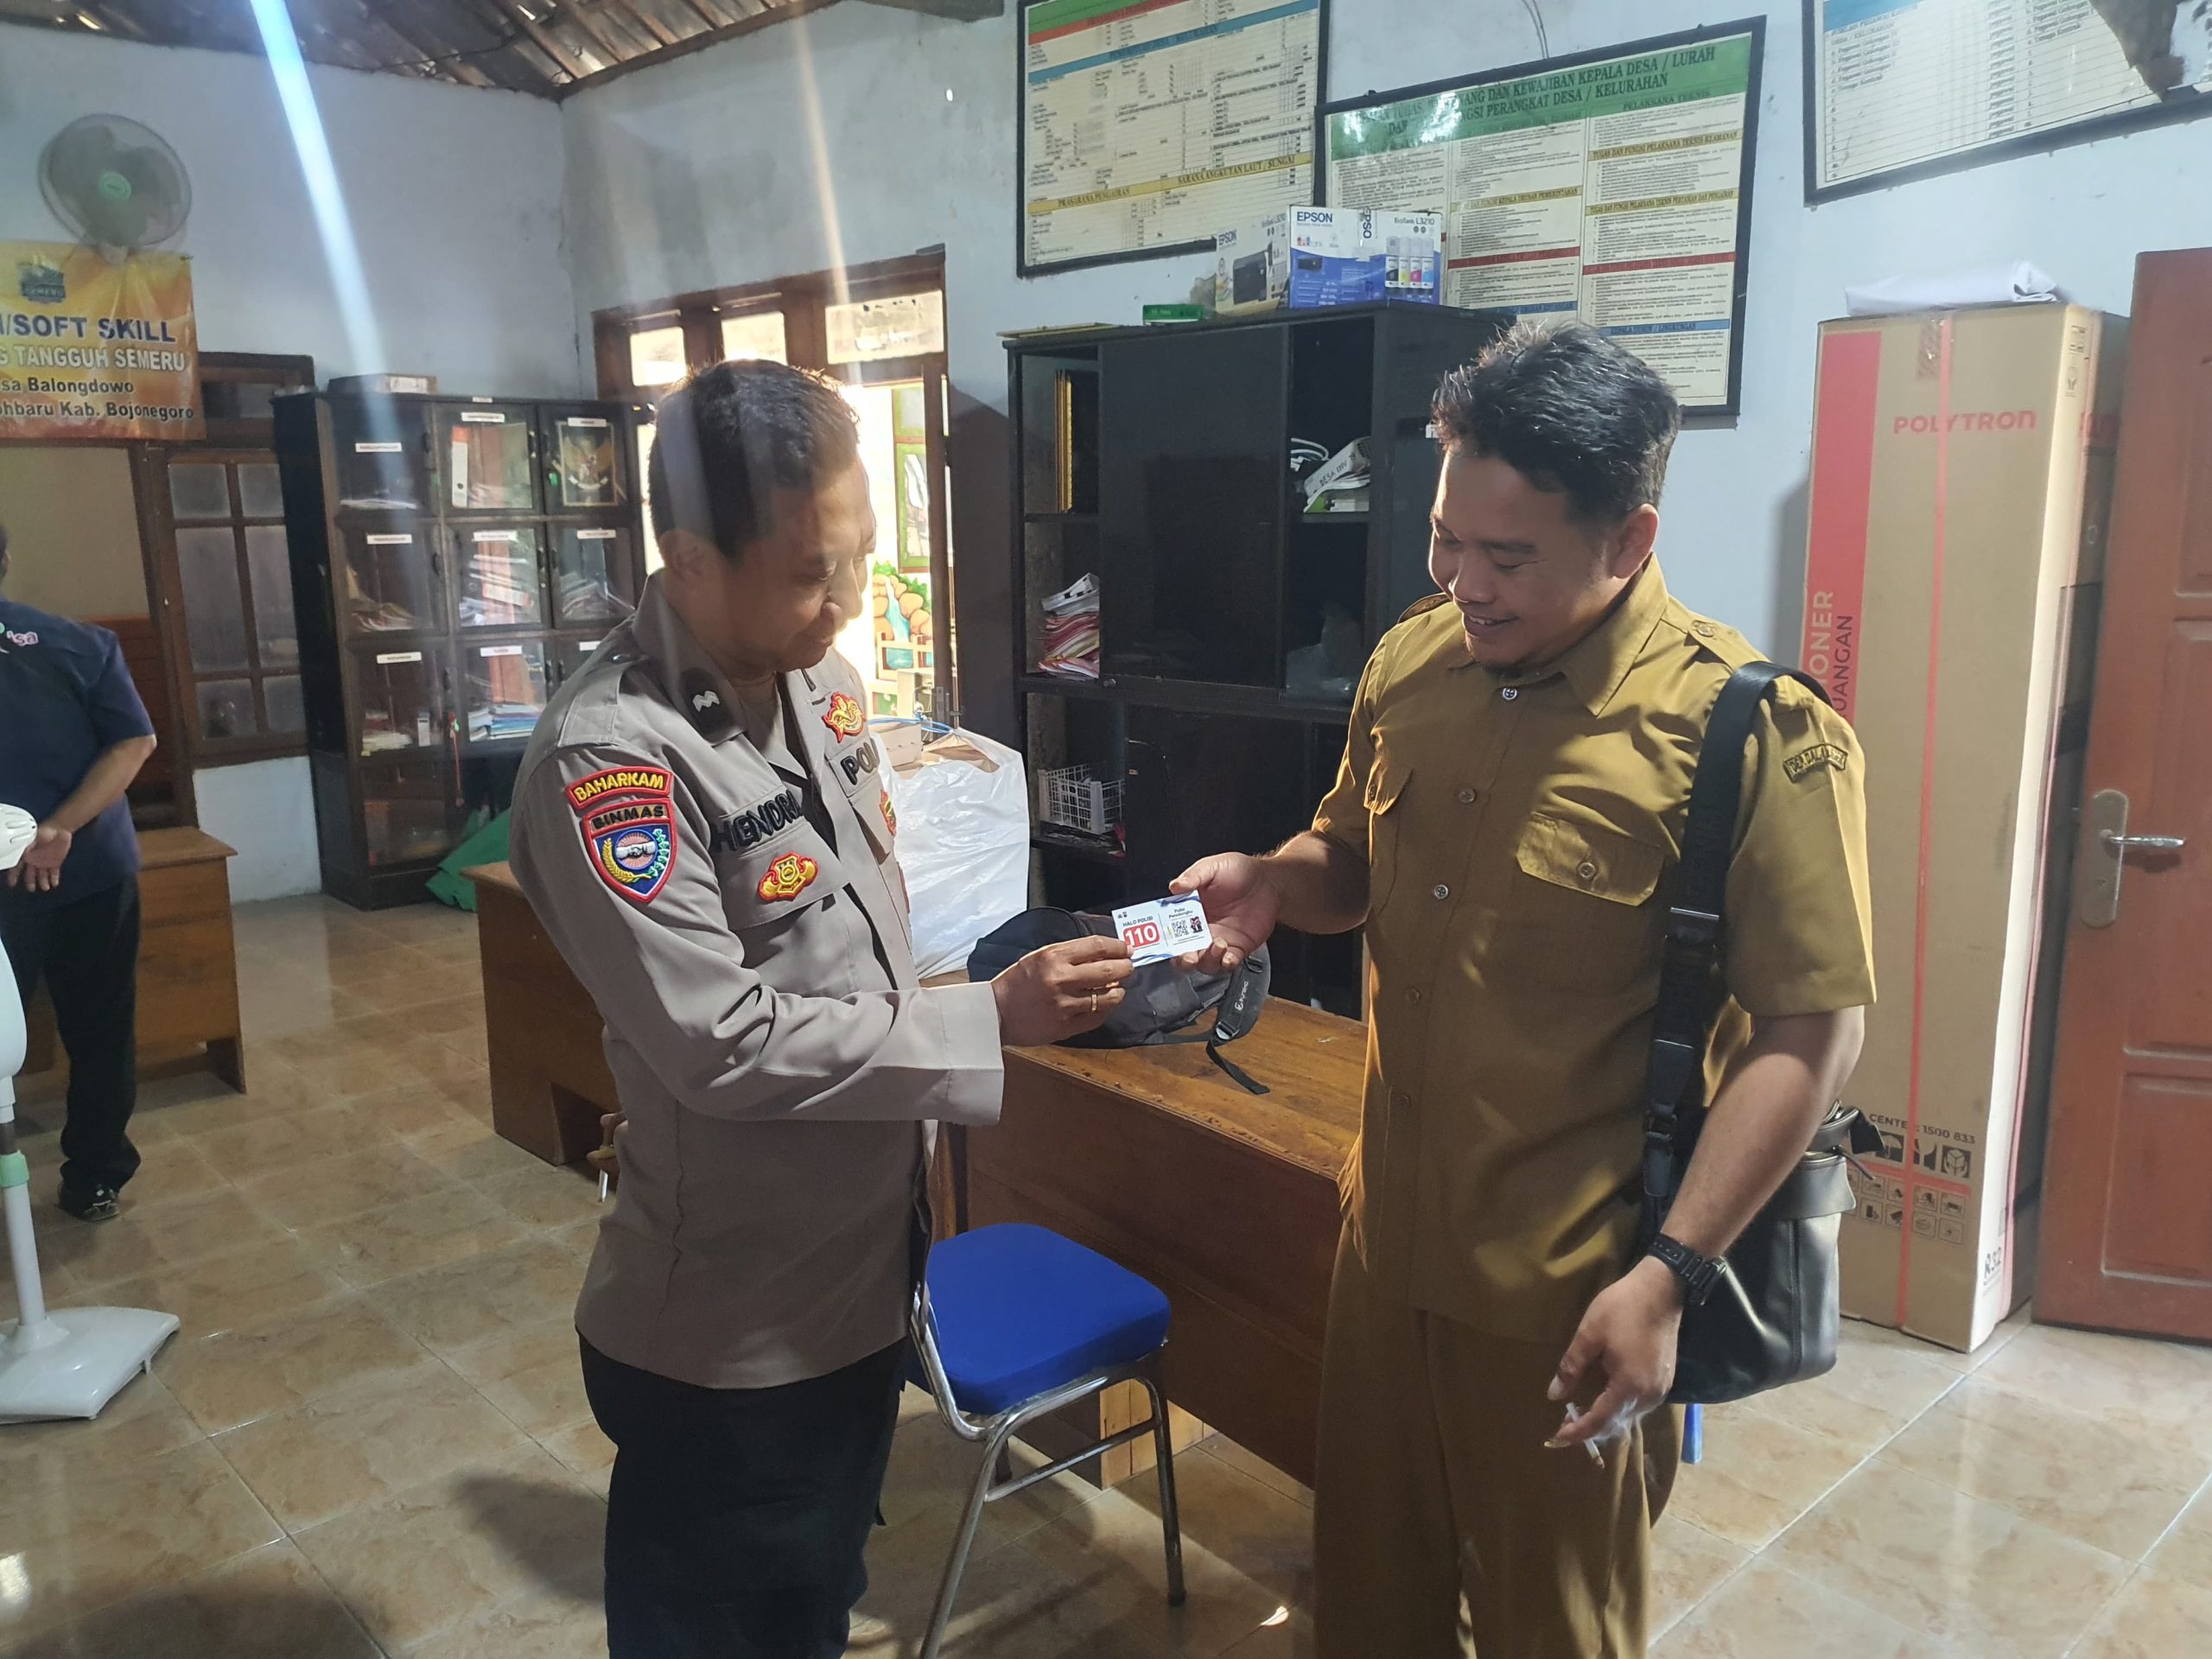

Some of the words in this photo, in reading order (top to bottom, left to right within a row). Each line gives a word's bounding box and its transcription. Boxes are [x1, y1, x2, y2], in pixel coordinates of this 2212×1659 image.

[1488, 84, 1510, 99] DAN
[1514, 72, 1575, 96] KEWAJIBAN
[1579, 65, 1624, 87] KEPALA
[1626, 59, 1658, 76] DESA
[1672, 47, 1716, 67] LURAH
[1486, 95, 1550, 118] PERANGKAT
[1553, 86, 1582, 105] DESA
[1596, 73, 1668, 98] KELURAHAN
[1297, 212, 1332, 223] EPSON
[98, 317, 175, 343] SKILL
[16, 346, 109, 369] TANGGUH
[115, 348, 185, 372] SEMERU
[27, 378, 134, 396] Balongdowo
[61, 402, 100, 417] Kab.
[106, 402, 194, 422] Bojonegoro
[1893, 410, 2037, 435] POLYTRON
[1832, 615, 1853, 712] UANGAN
[573, 772, 664, 802] BAHARKAM
[592, 805, 664, 830] BINMAS
[1137, 916, 1154, 925] POLISI
[1124, 925, 1158, 948] 110
[1869, 1114, 1913, 1130] CENTE
[1923, 1125, 1950, 1139] 1500
[1954, 1133, 1976, 1144] 833
